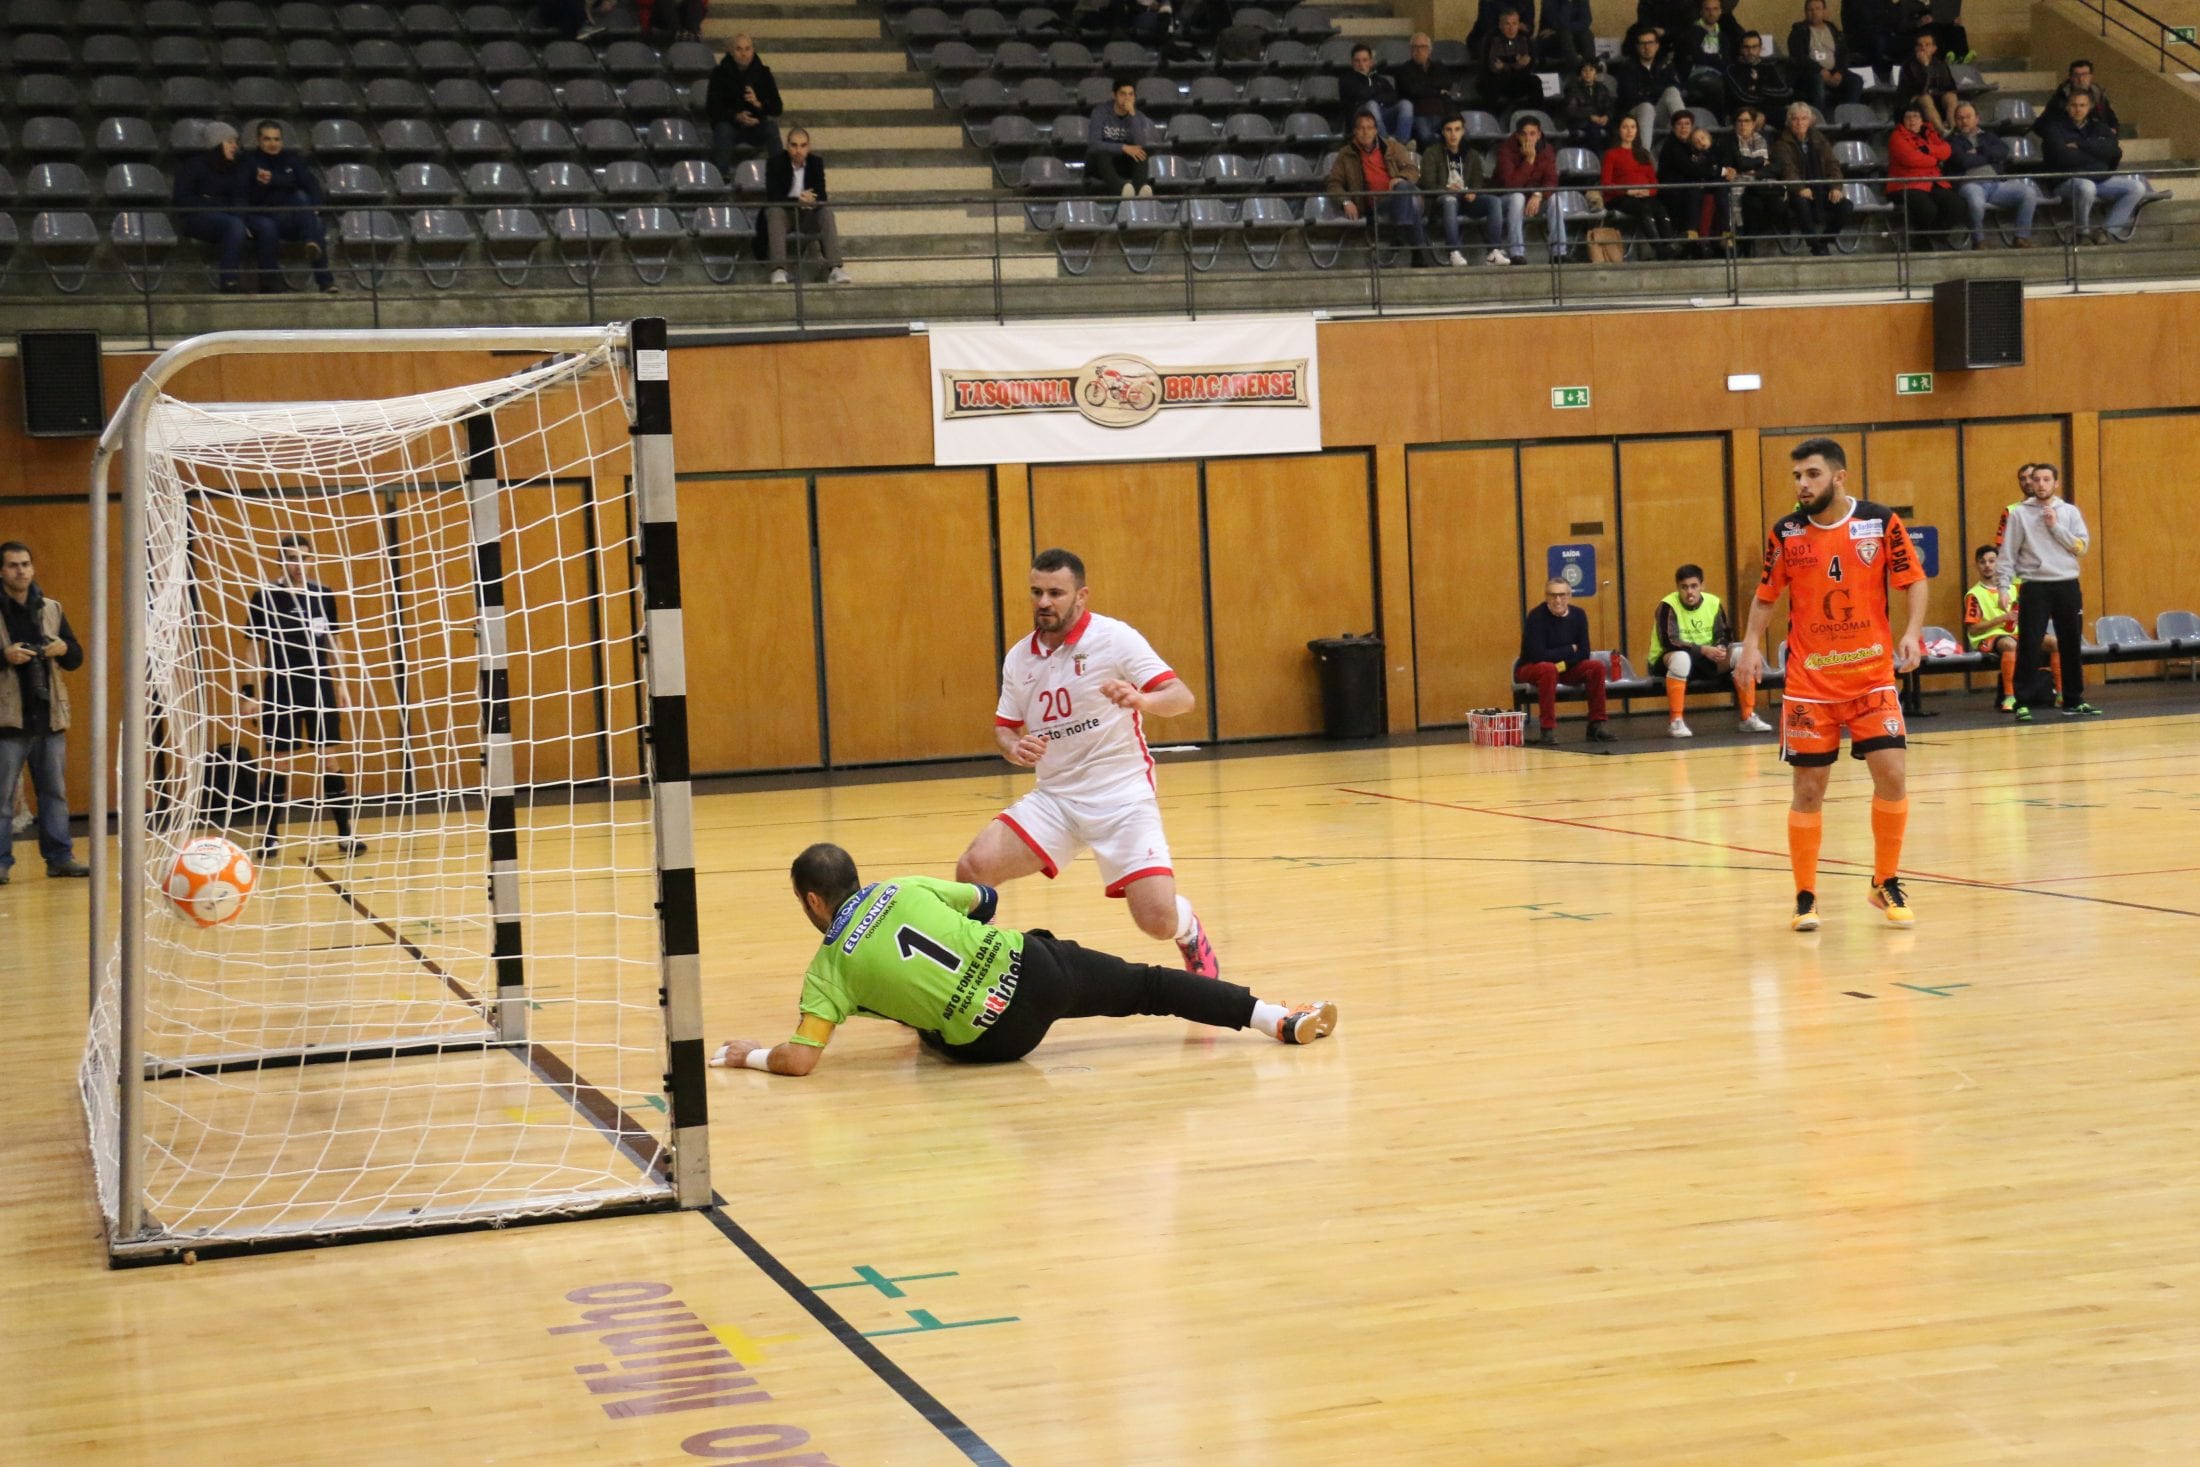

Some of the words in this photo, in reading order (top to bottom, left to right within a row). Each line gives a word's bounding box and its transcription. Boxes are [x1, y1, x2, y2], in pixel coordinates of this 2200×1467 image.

[955, 379, 1072, 408] TASQUINHA
[1164, 371, 1295, 401] BRACARENSE
[1828, 555, 1843, 583] 4
[1823, 589, 1854, 622] G
[1039, 687, 1072, 722] 20
[1066, 718, 1100, 737] norte
[845, 887, 898, 951] EURONICS
[865, 900, 897, 939] GONDOMAR
[895, 924, 962, 973] 1
[942, 994, 961, 1021] AUTO
[956, 960, 981, 994] FONTE
[976, 946, 989, 961] DA
[958, 991, 976, 1014] PEÇAS
[547, 1282, 774, 1420] Minho
